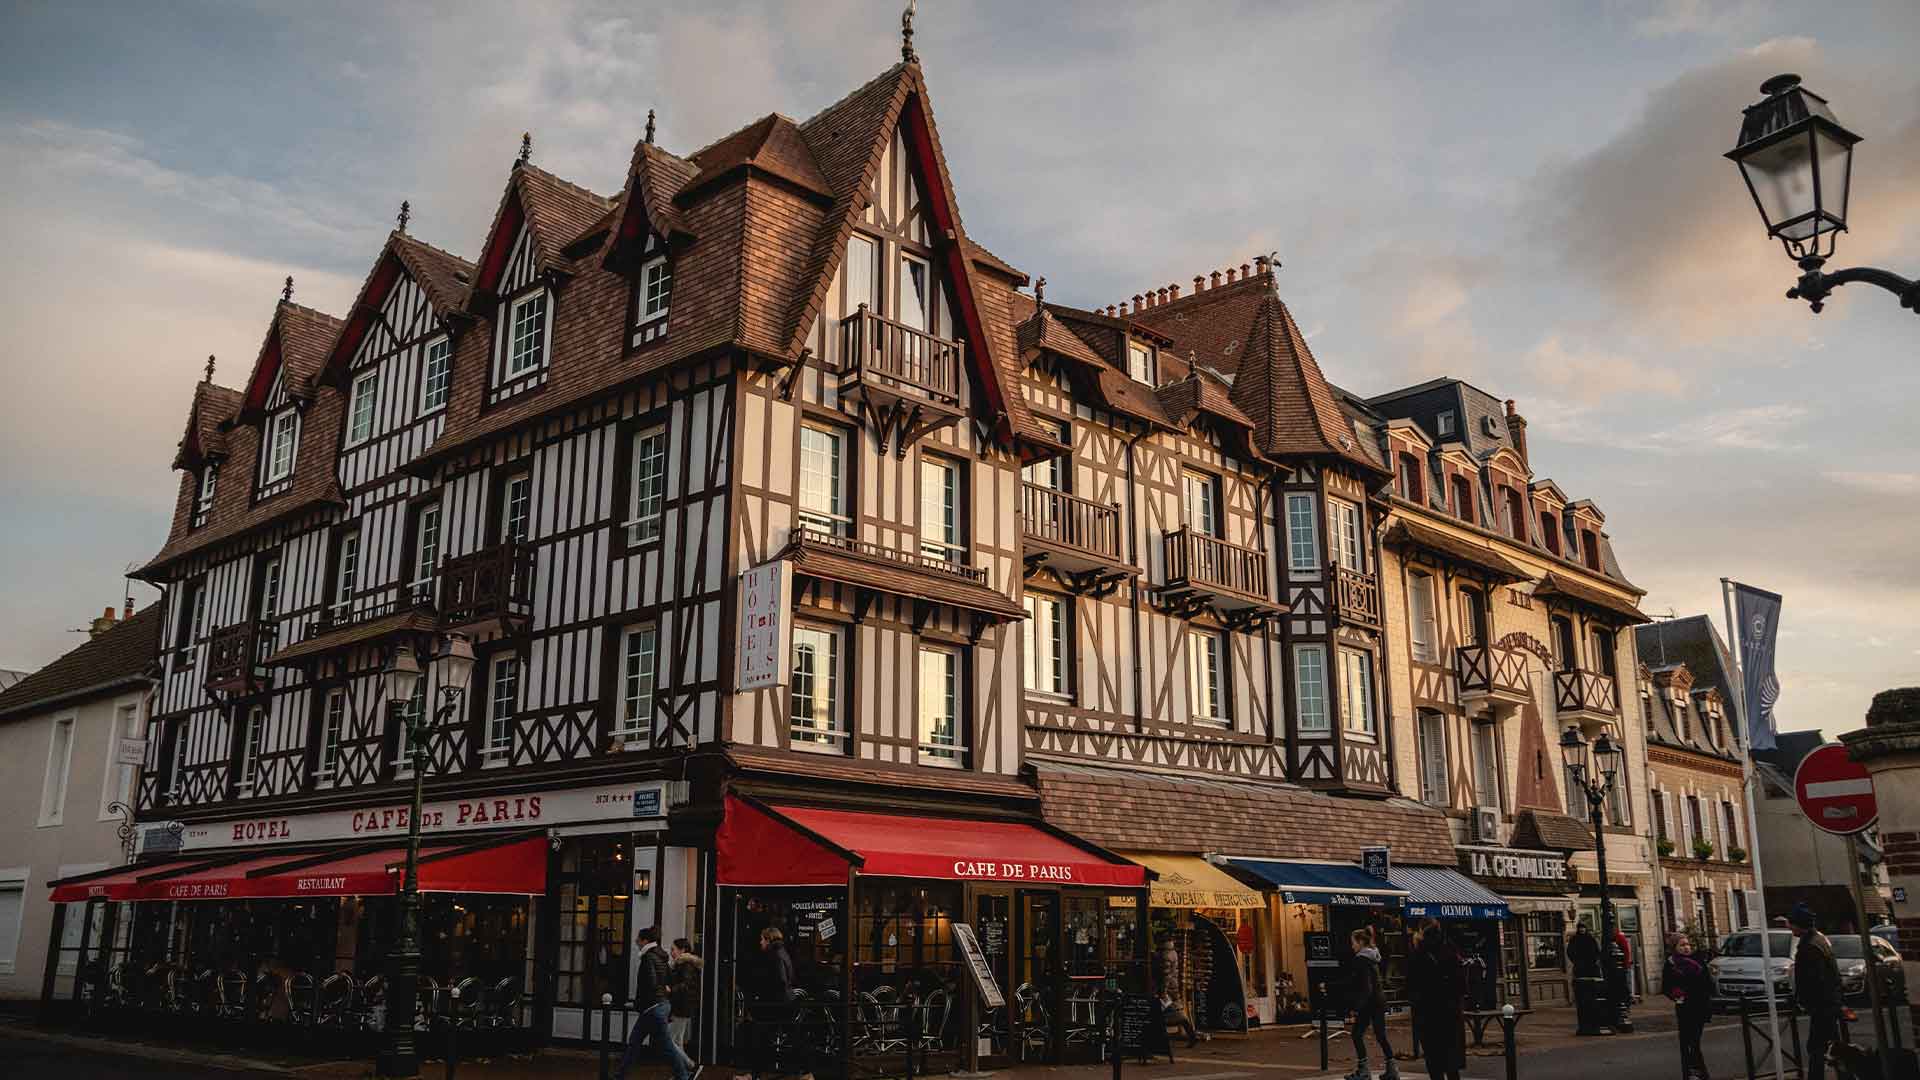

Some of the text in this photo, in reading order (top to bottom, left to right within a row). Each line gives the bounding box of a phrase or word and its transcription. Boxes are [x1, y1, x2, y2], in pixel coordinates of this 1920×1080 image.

[746, 573, 758, 672] HOTEL
[353, 796, 541, 832] CAFE DE PARIS
[233, 820, 290, 841] HOTEL
[954, 861, 1072, 880] CAFE DE PARIS
[1471, 852, 1489, 876] LA
[169, 883, 228, 897] CAFE DE PARIS
[297, 877, 346, 891] RESTAURANT
[1164, 891, 1207, 906] CADEAUX
[1441, 905, 1473, 917] OLYMPIA
